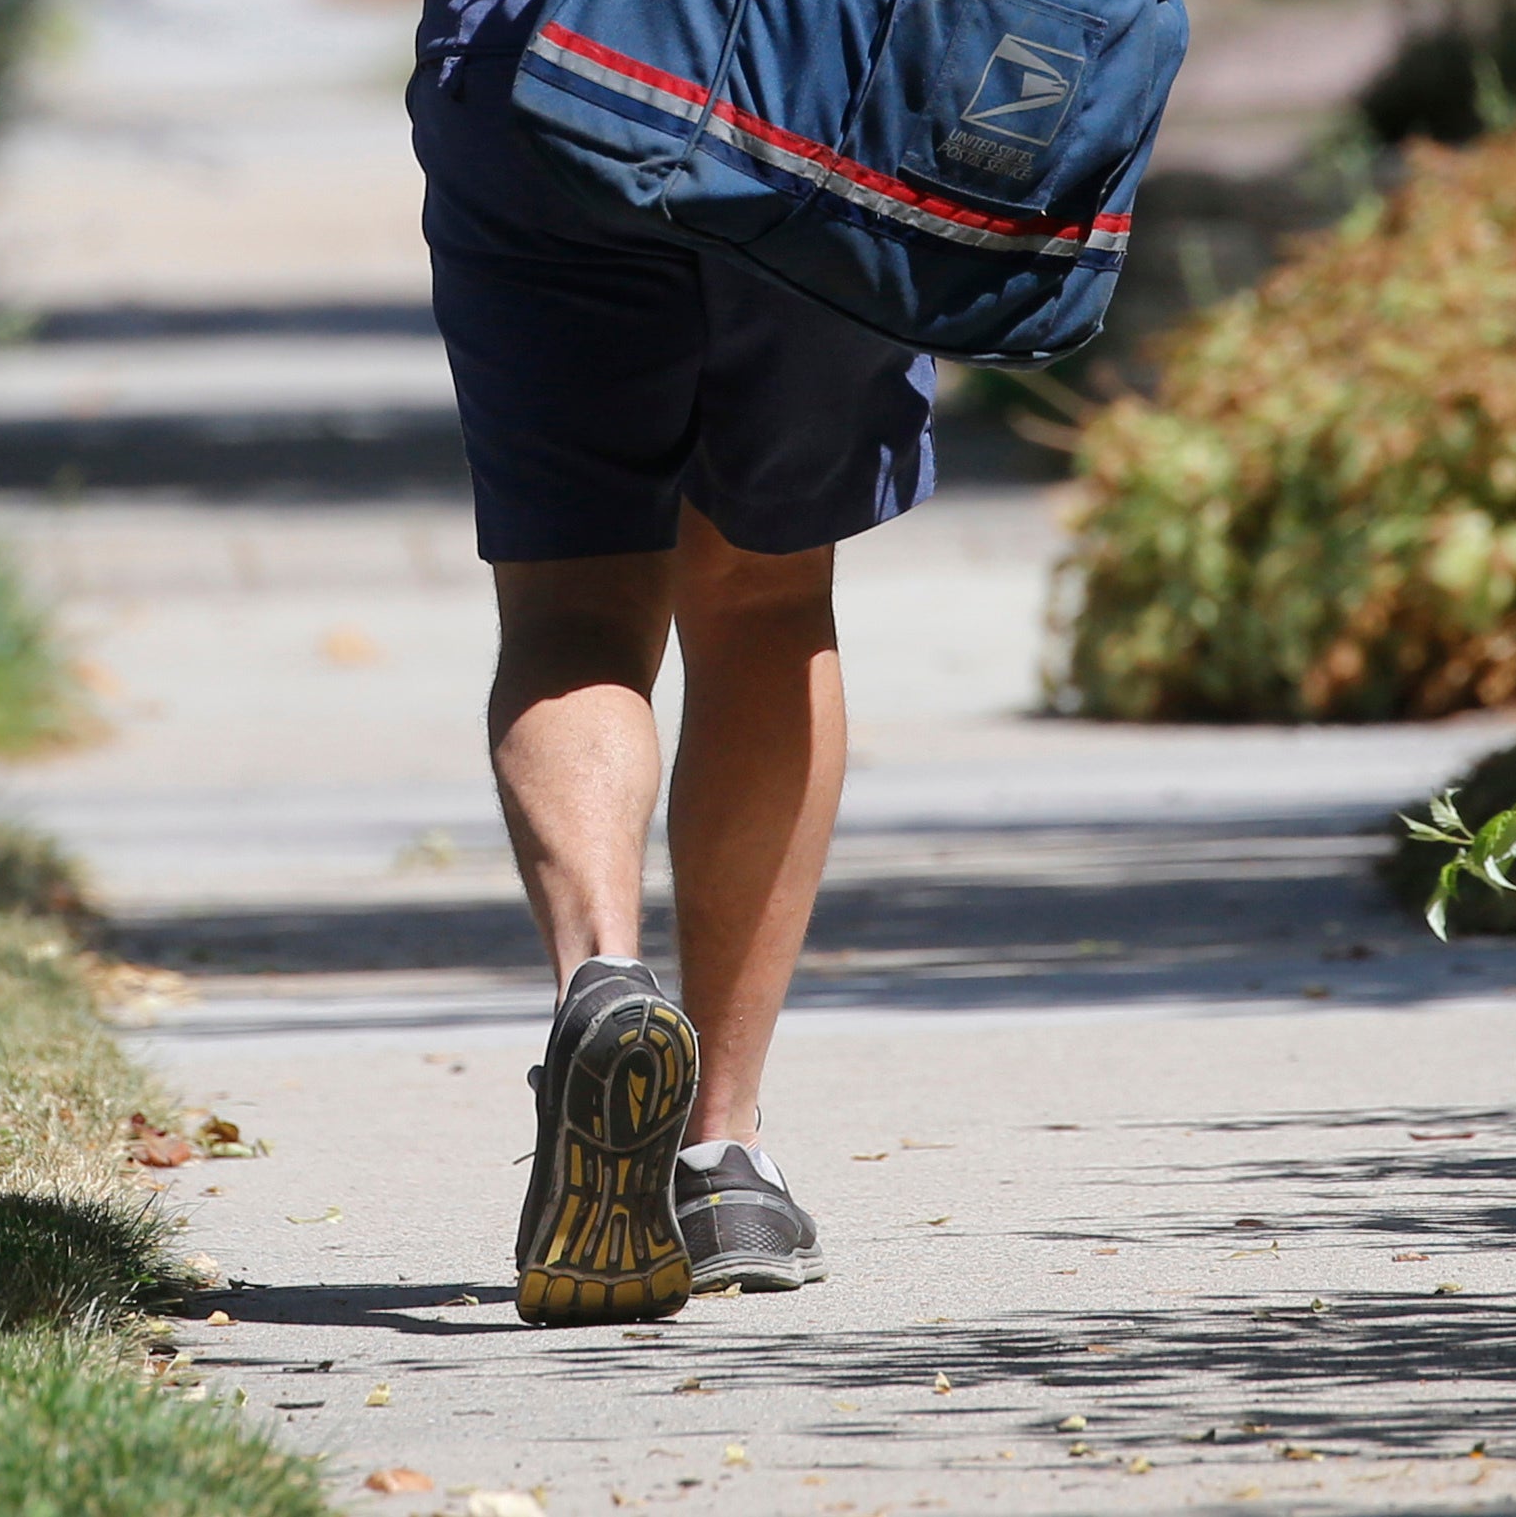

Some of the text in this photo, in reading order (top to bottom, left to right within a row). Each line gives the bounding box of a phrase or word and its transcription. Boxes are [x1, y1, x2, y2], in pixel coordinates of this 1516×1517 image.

[936, 143, 1033, 181] POSTAL SERVICE
[948, 126, 1036, 165] UNITED STATES
